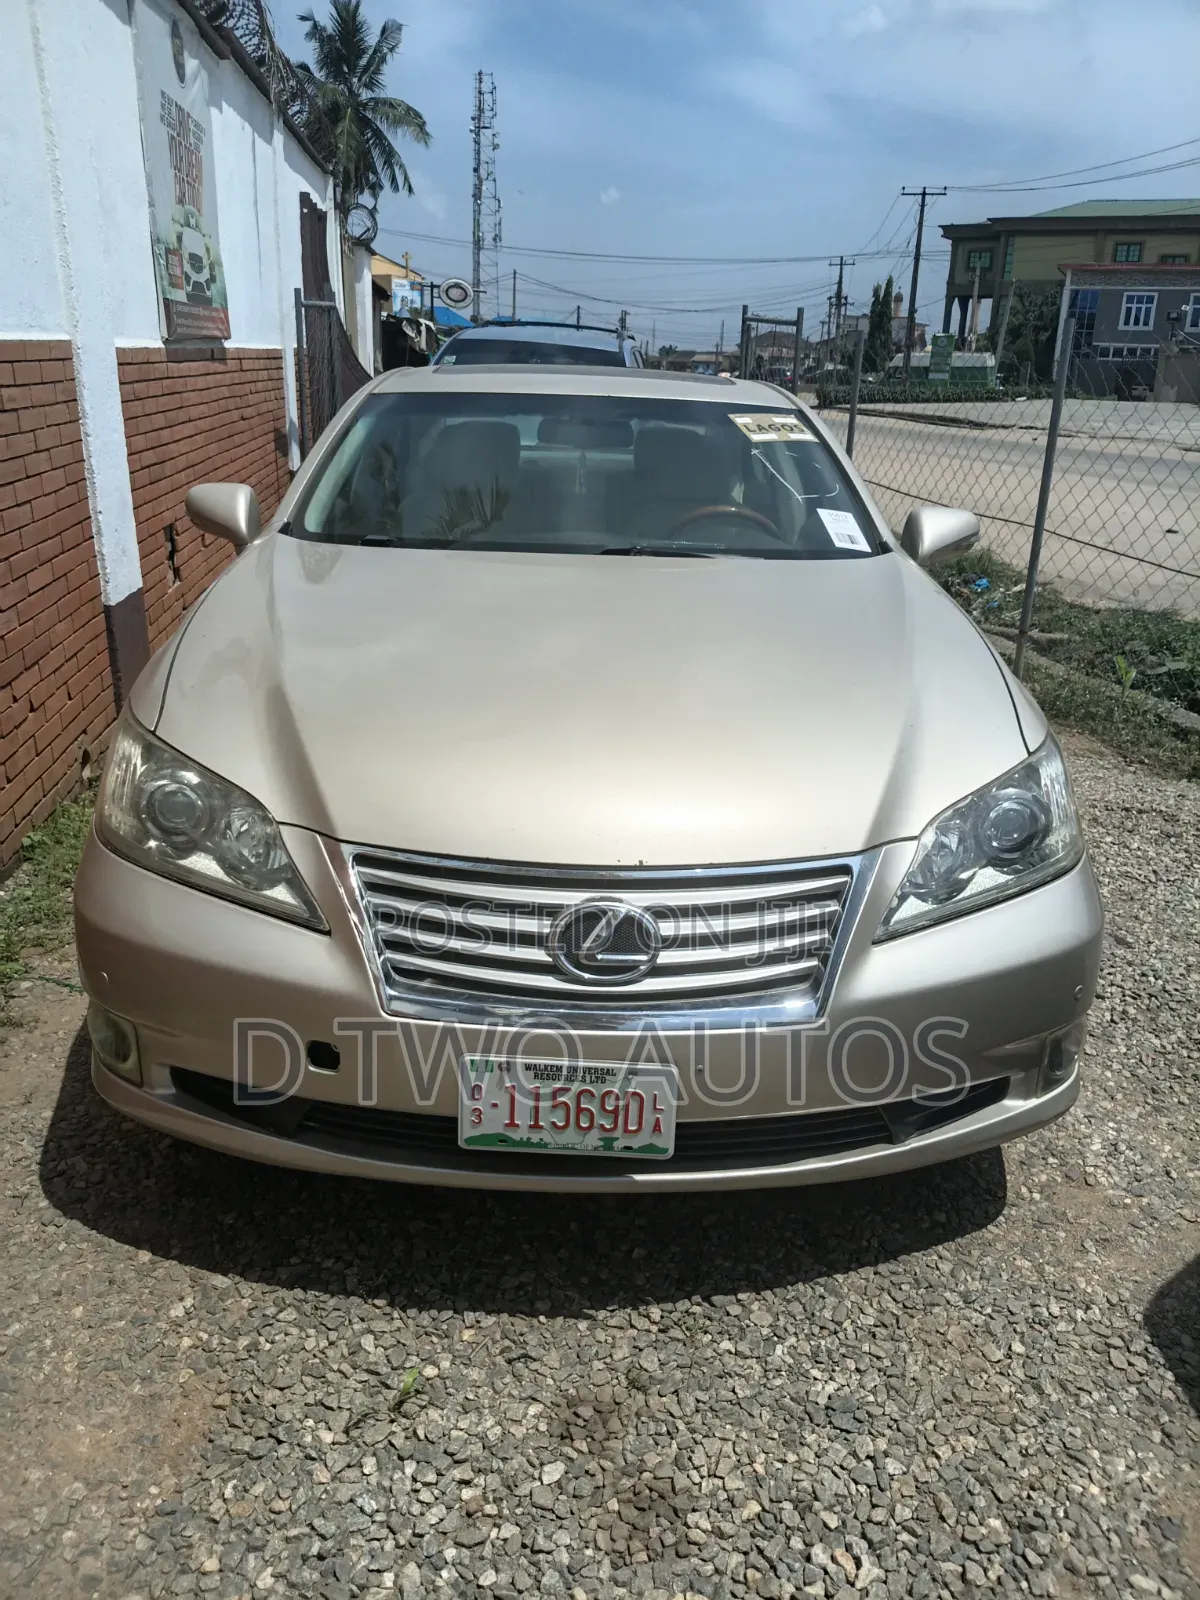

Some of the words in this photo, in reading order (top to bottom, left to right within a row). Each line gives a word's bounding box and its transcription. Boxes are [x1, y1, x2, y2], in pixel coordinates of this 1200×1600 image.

[174, 100, 193, 148] DRIVE
[743, 423, 806, 433] LAGOS
[524, 1062, 564, 1073] WALKEM
[566, 1065, 617, 1077] UNIVERSAL
[533, 1071, 587, 1083] RESOURCES
[589, 1075, 607, 1084] LTD
